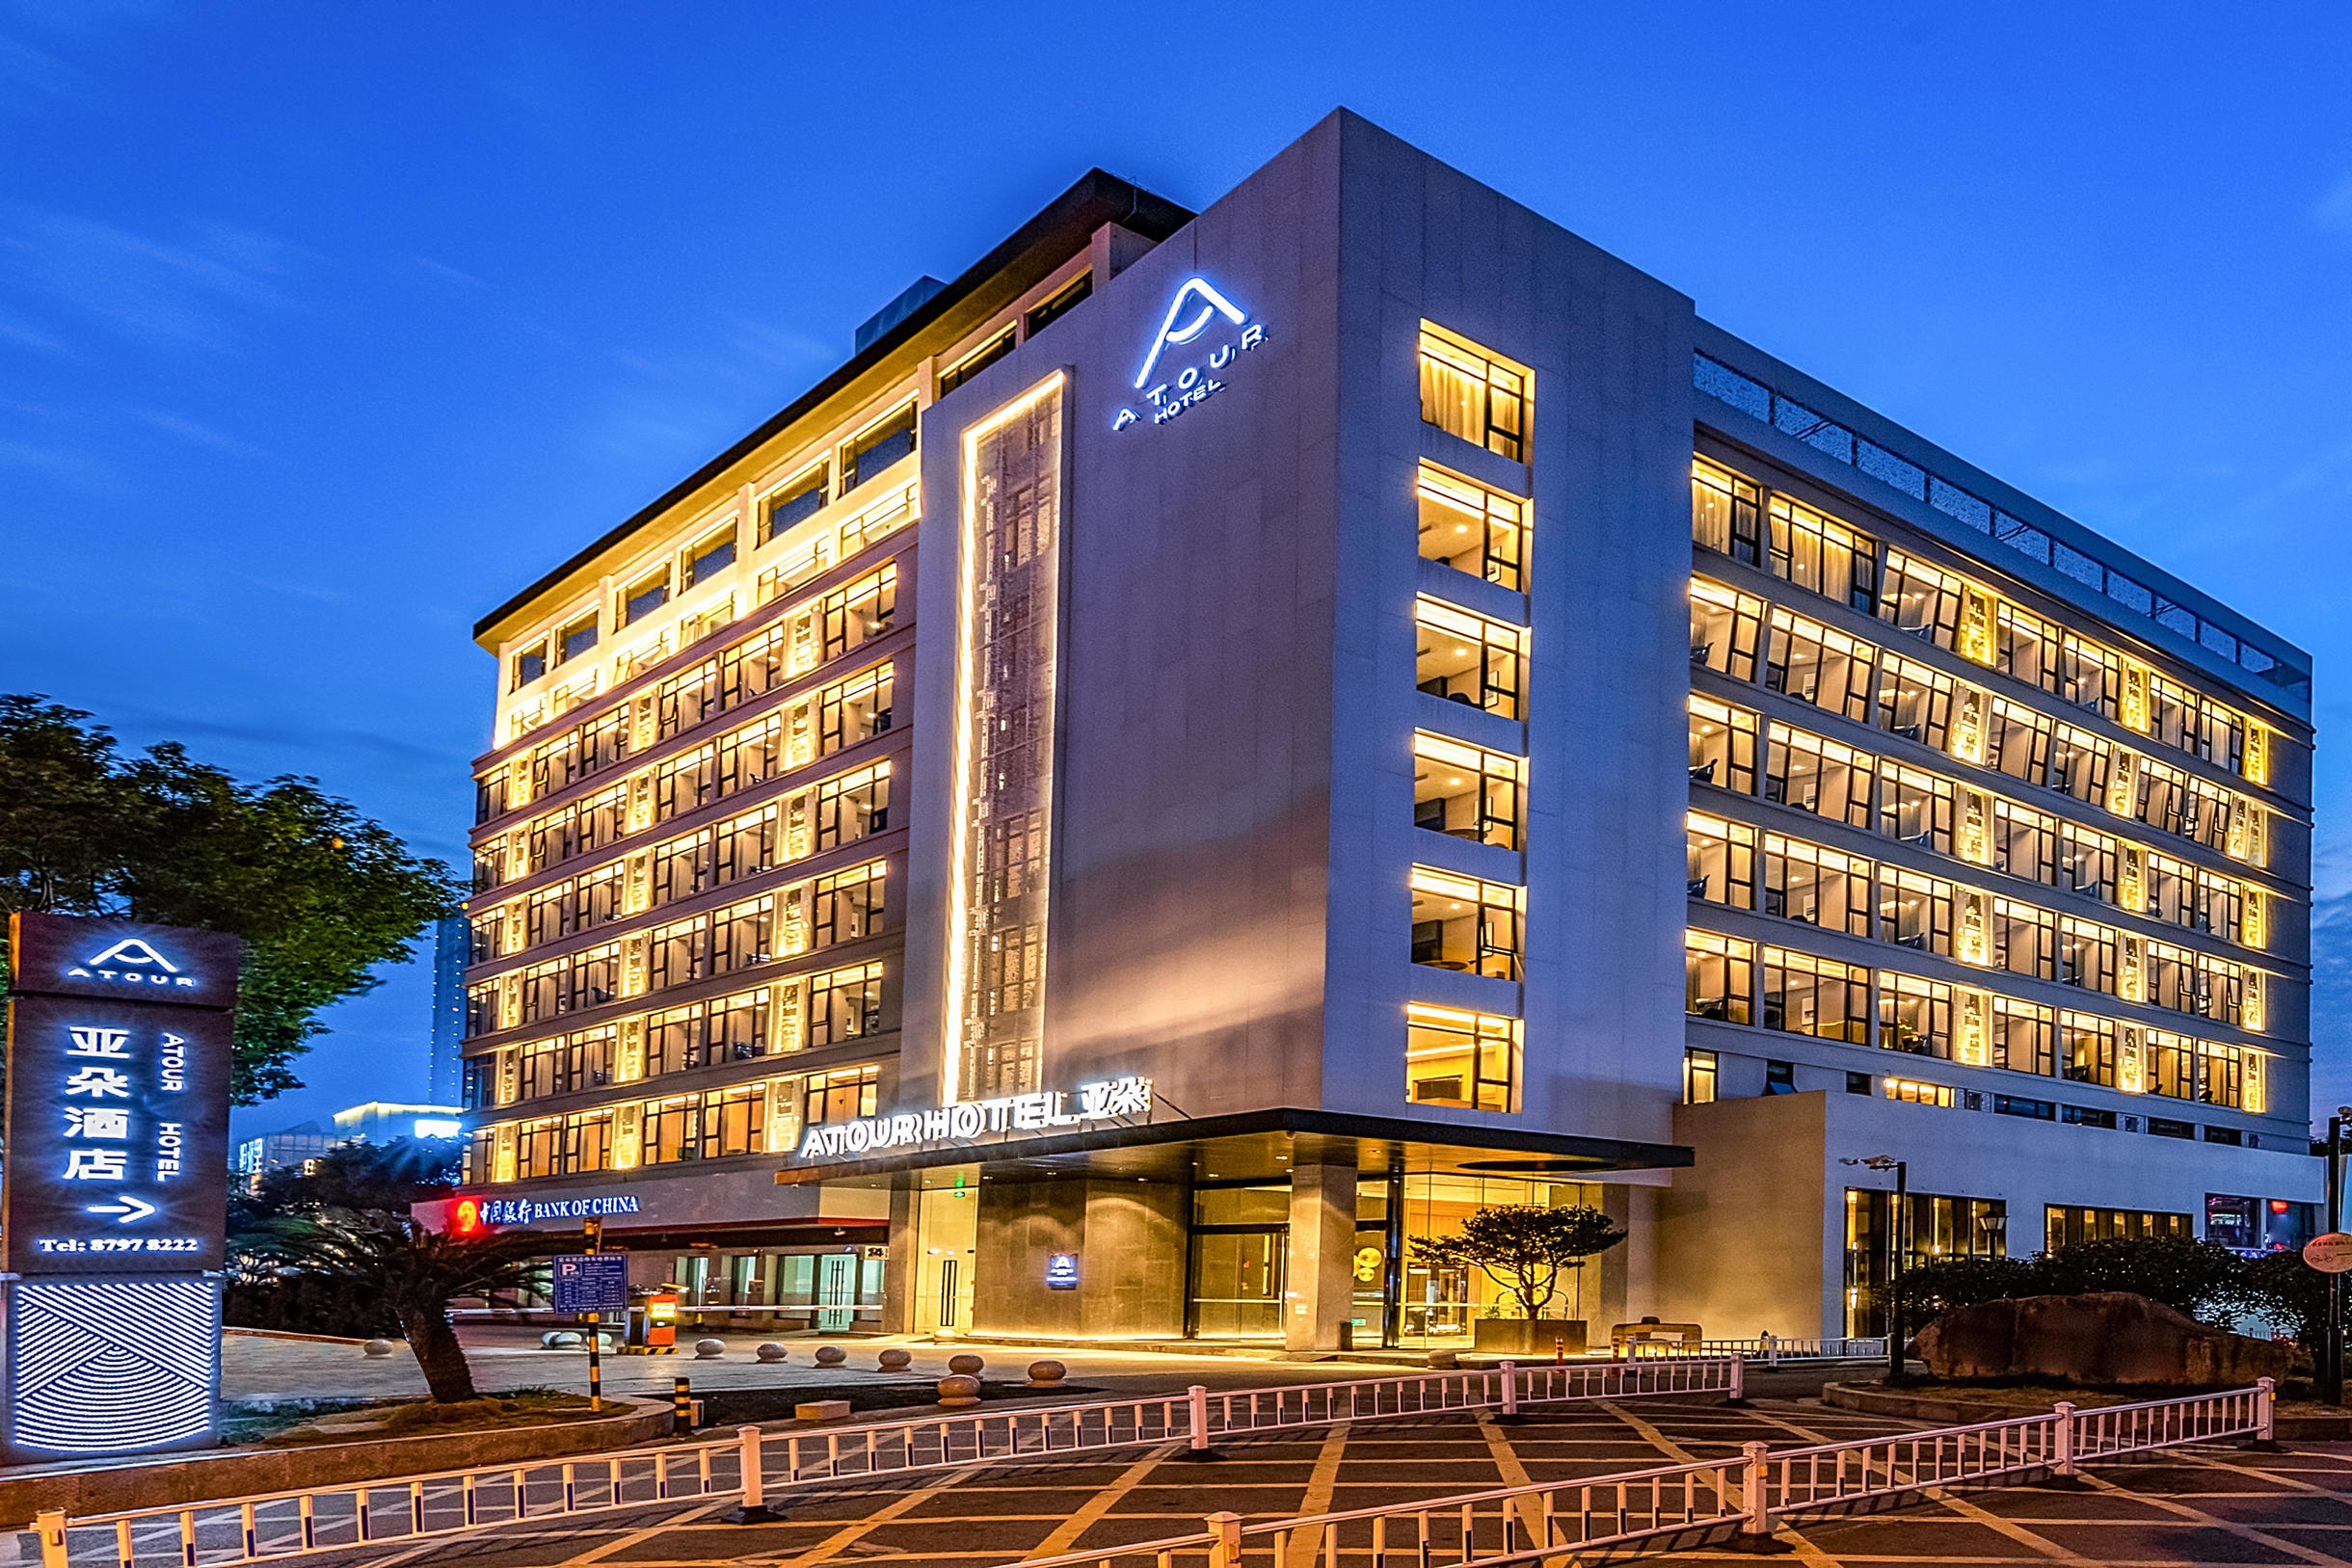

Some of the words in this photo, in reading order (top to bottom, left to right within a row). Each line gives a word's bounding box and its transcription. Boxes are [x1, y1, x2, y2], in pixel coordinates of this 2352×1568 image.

[1112, 324, 1269, 431] ATOUR
[1154, 379, 1225, 424] HOTEL
[67, 967, 196, 988] ATOUR
[160, 1032, 185, 1092] ATOUR
[63, 1025, 131, 1181] 亚朵酒店
[157, 1122, 183, 1182] HOTEL
[534, 1202, 571, 1218] BANK
[572, 1199, 591, 1215] OF
[591, 1196, 640, 1214] CHINA
[39, 1238, 86, 1252] Tel:
[90, 1238, 144, 1252] 8797
[146, 1238, 198, 1252] 8222
[562, 1263, 577, 1276] P
